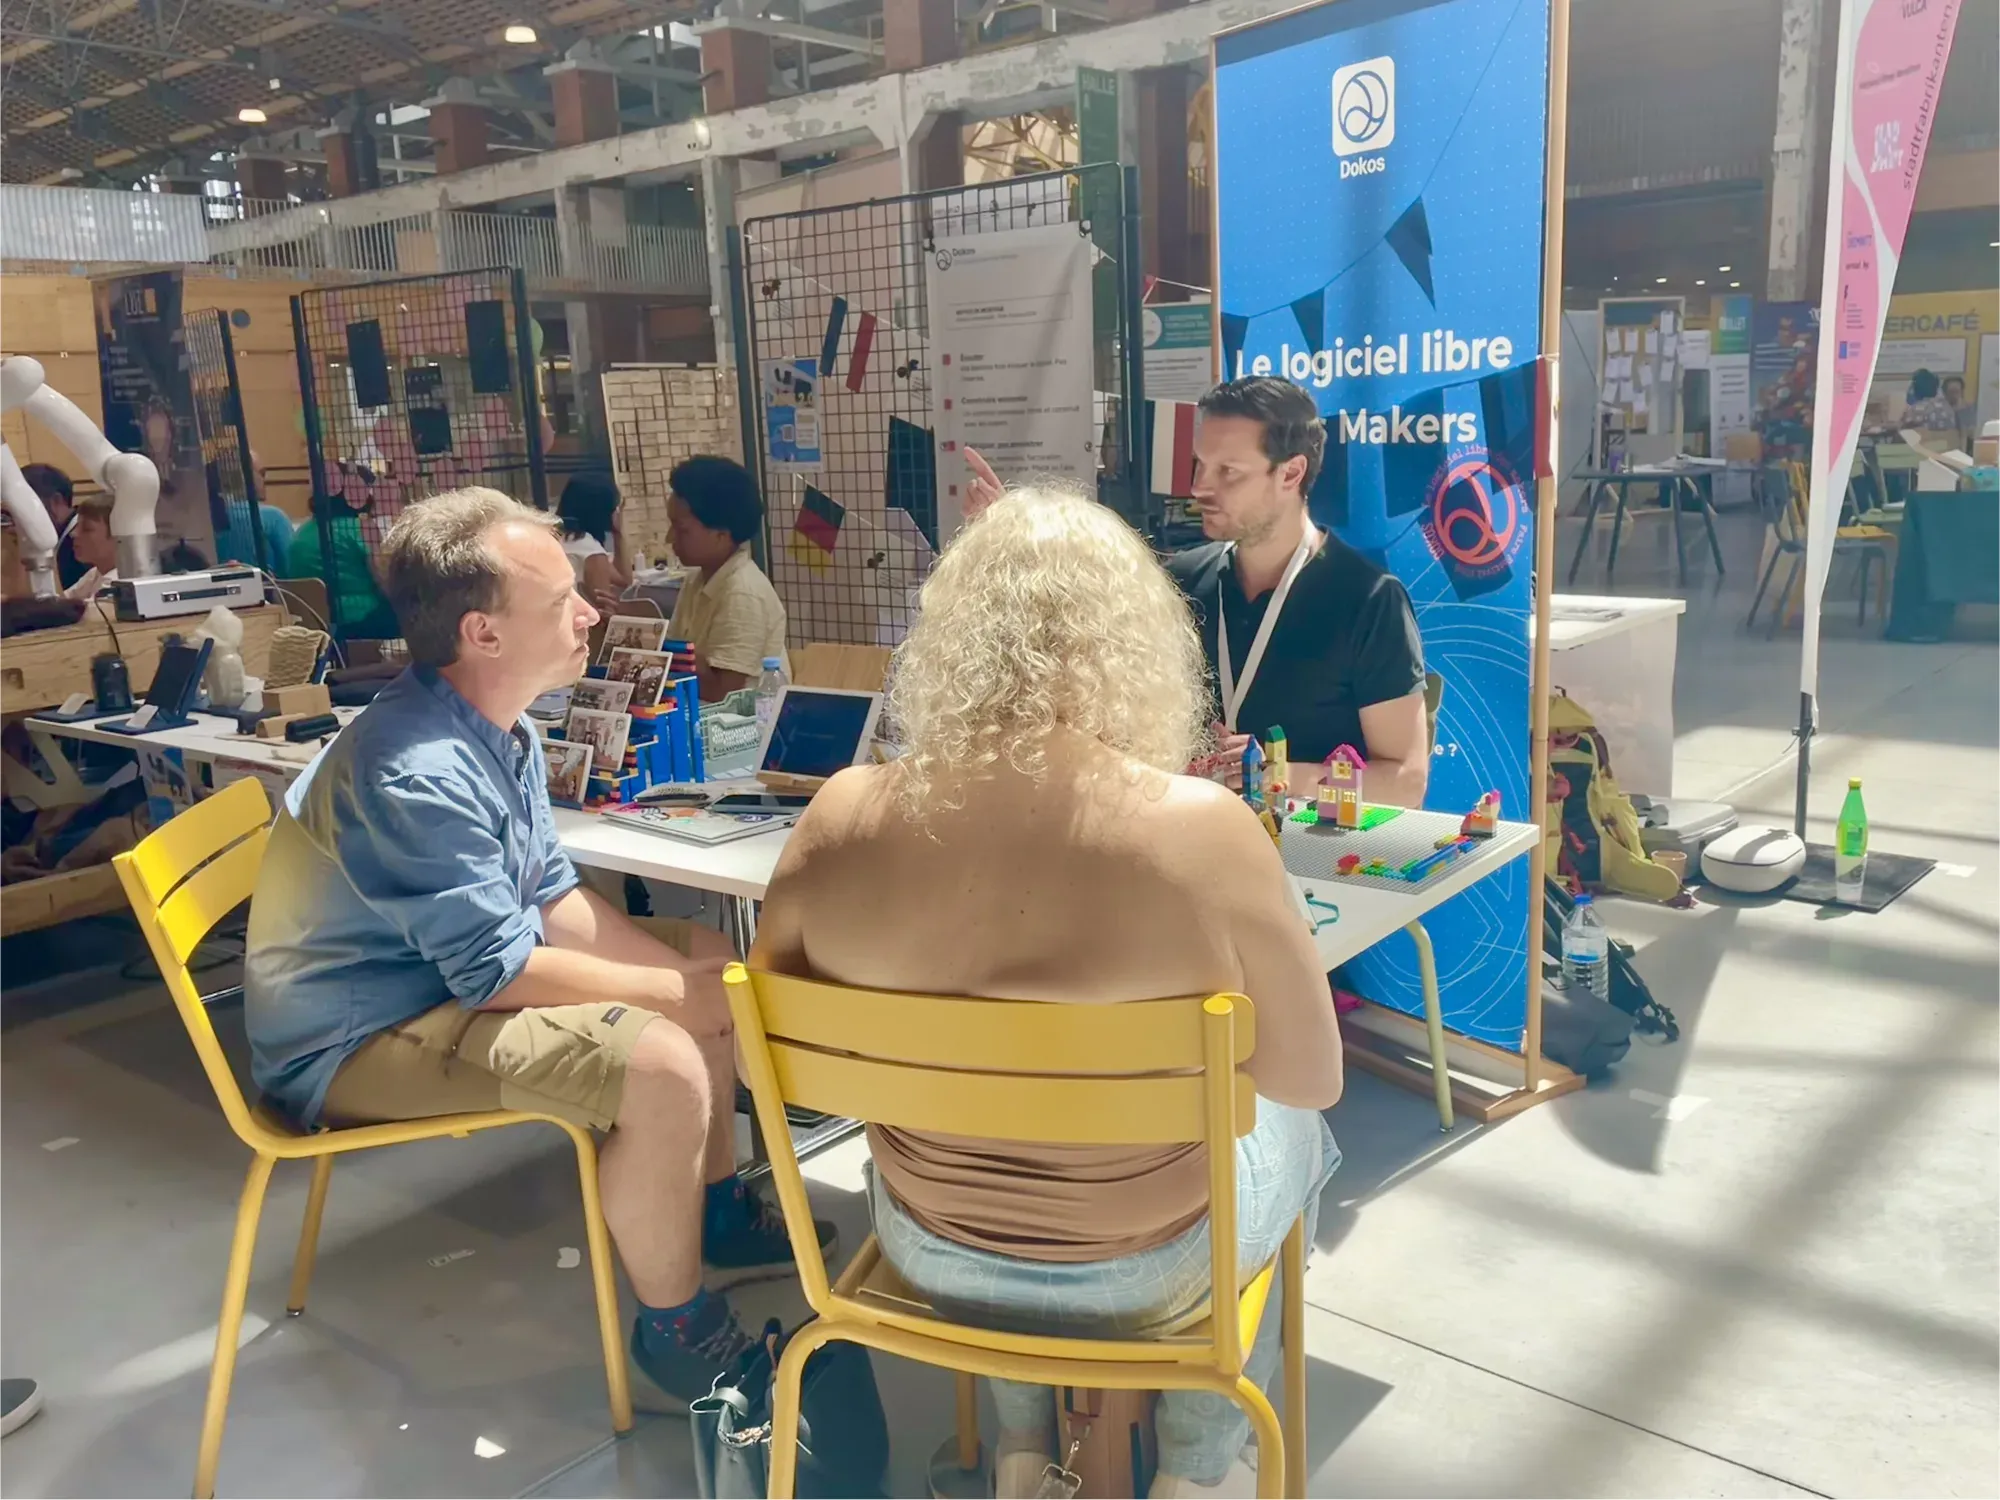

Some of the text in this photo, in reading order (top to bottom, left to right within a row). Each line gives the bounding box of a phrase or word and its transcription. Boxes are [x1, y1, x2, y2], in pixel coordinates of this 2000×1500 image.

[1903, 4, 1953, 190] stadtfabrikanten
[1340, 156, 1386, 179] Dokos
[1235, 329, 1513, 388] Le logiciel libre
[1339, 404, 1478, 445] Makers
